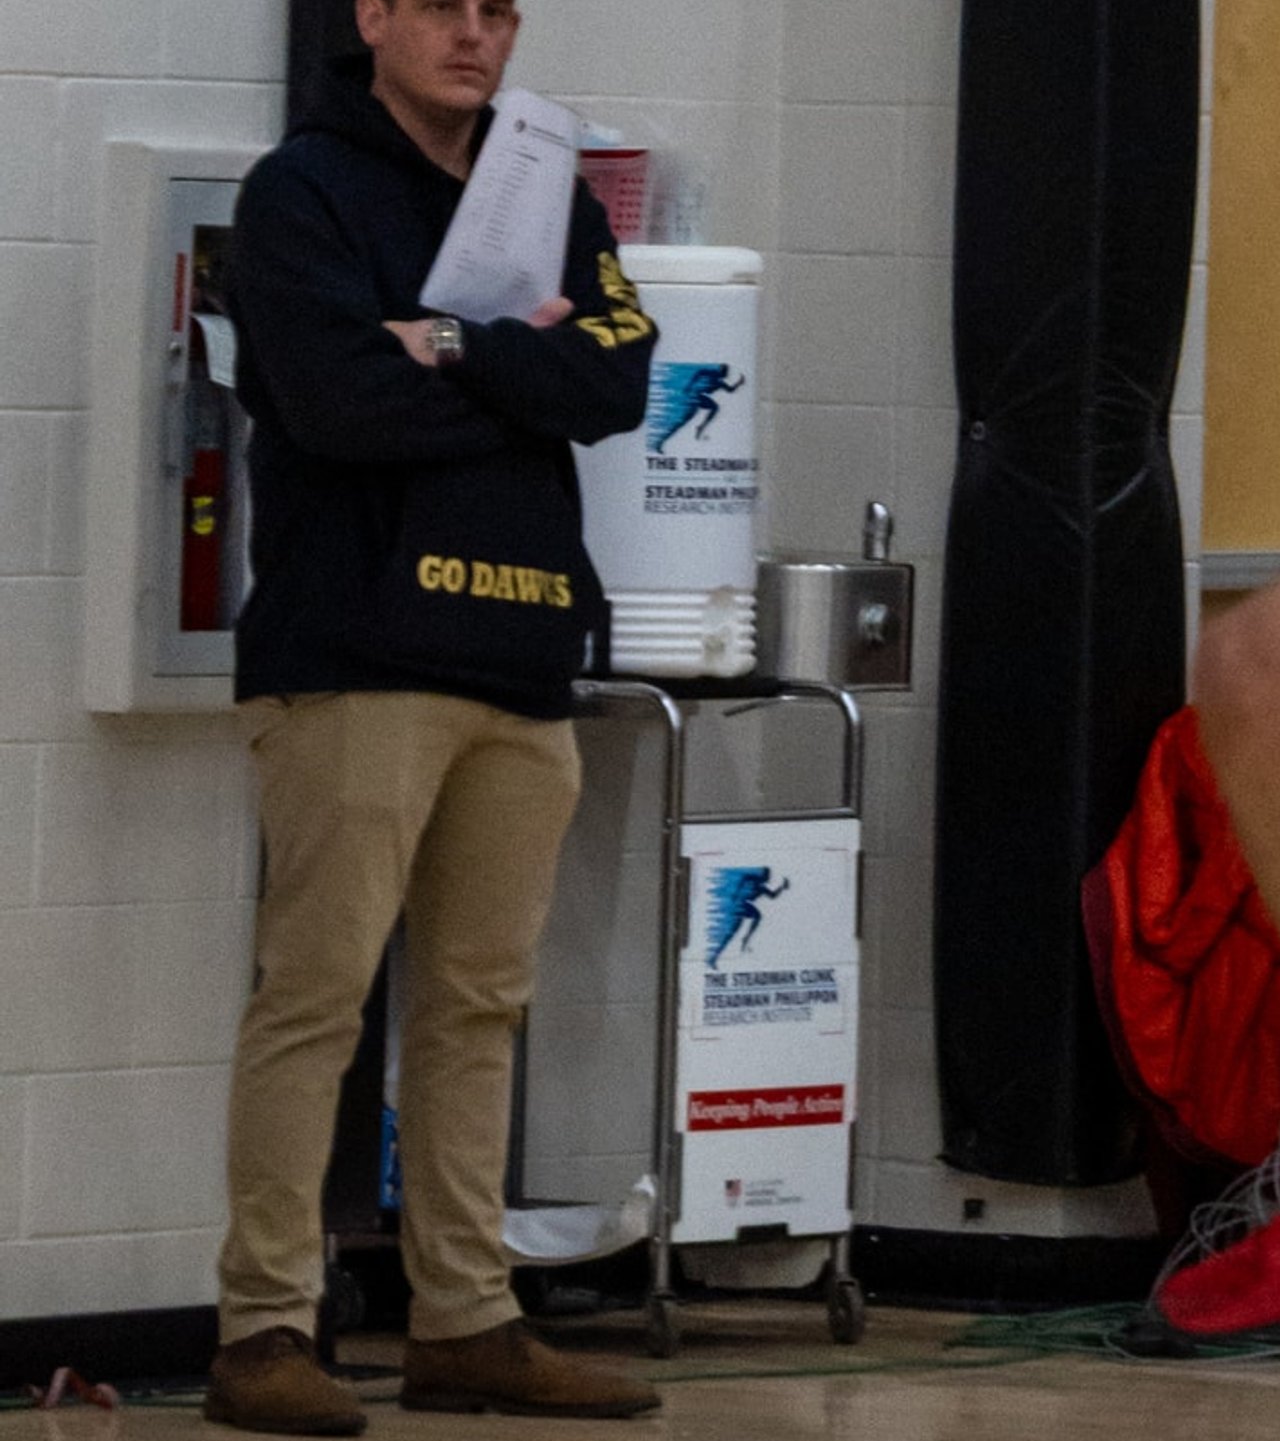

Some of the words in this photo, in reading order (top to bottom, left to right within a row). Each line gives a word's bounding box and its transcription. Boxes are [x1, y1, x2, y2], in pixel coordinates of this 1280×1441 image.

[645, 456, 677, 471] THE
[645, 485, 728, 500] STEADMAN
[416, 553, 467, 594] GO
[703, 972, 728, 988] THE
